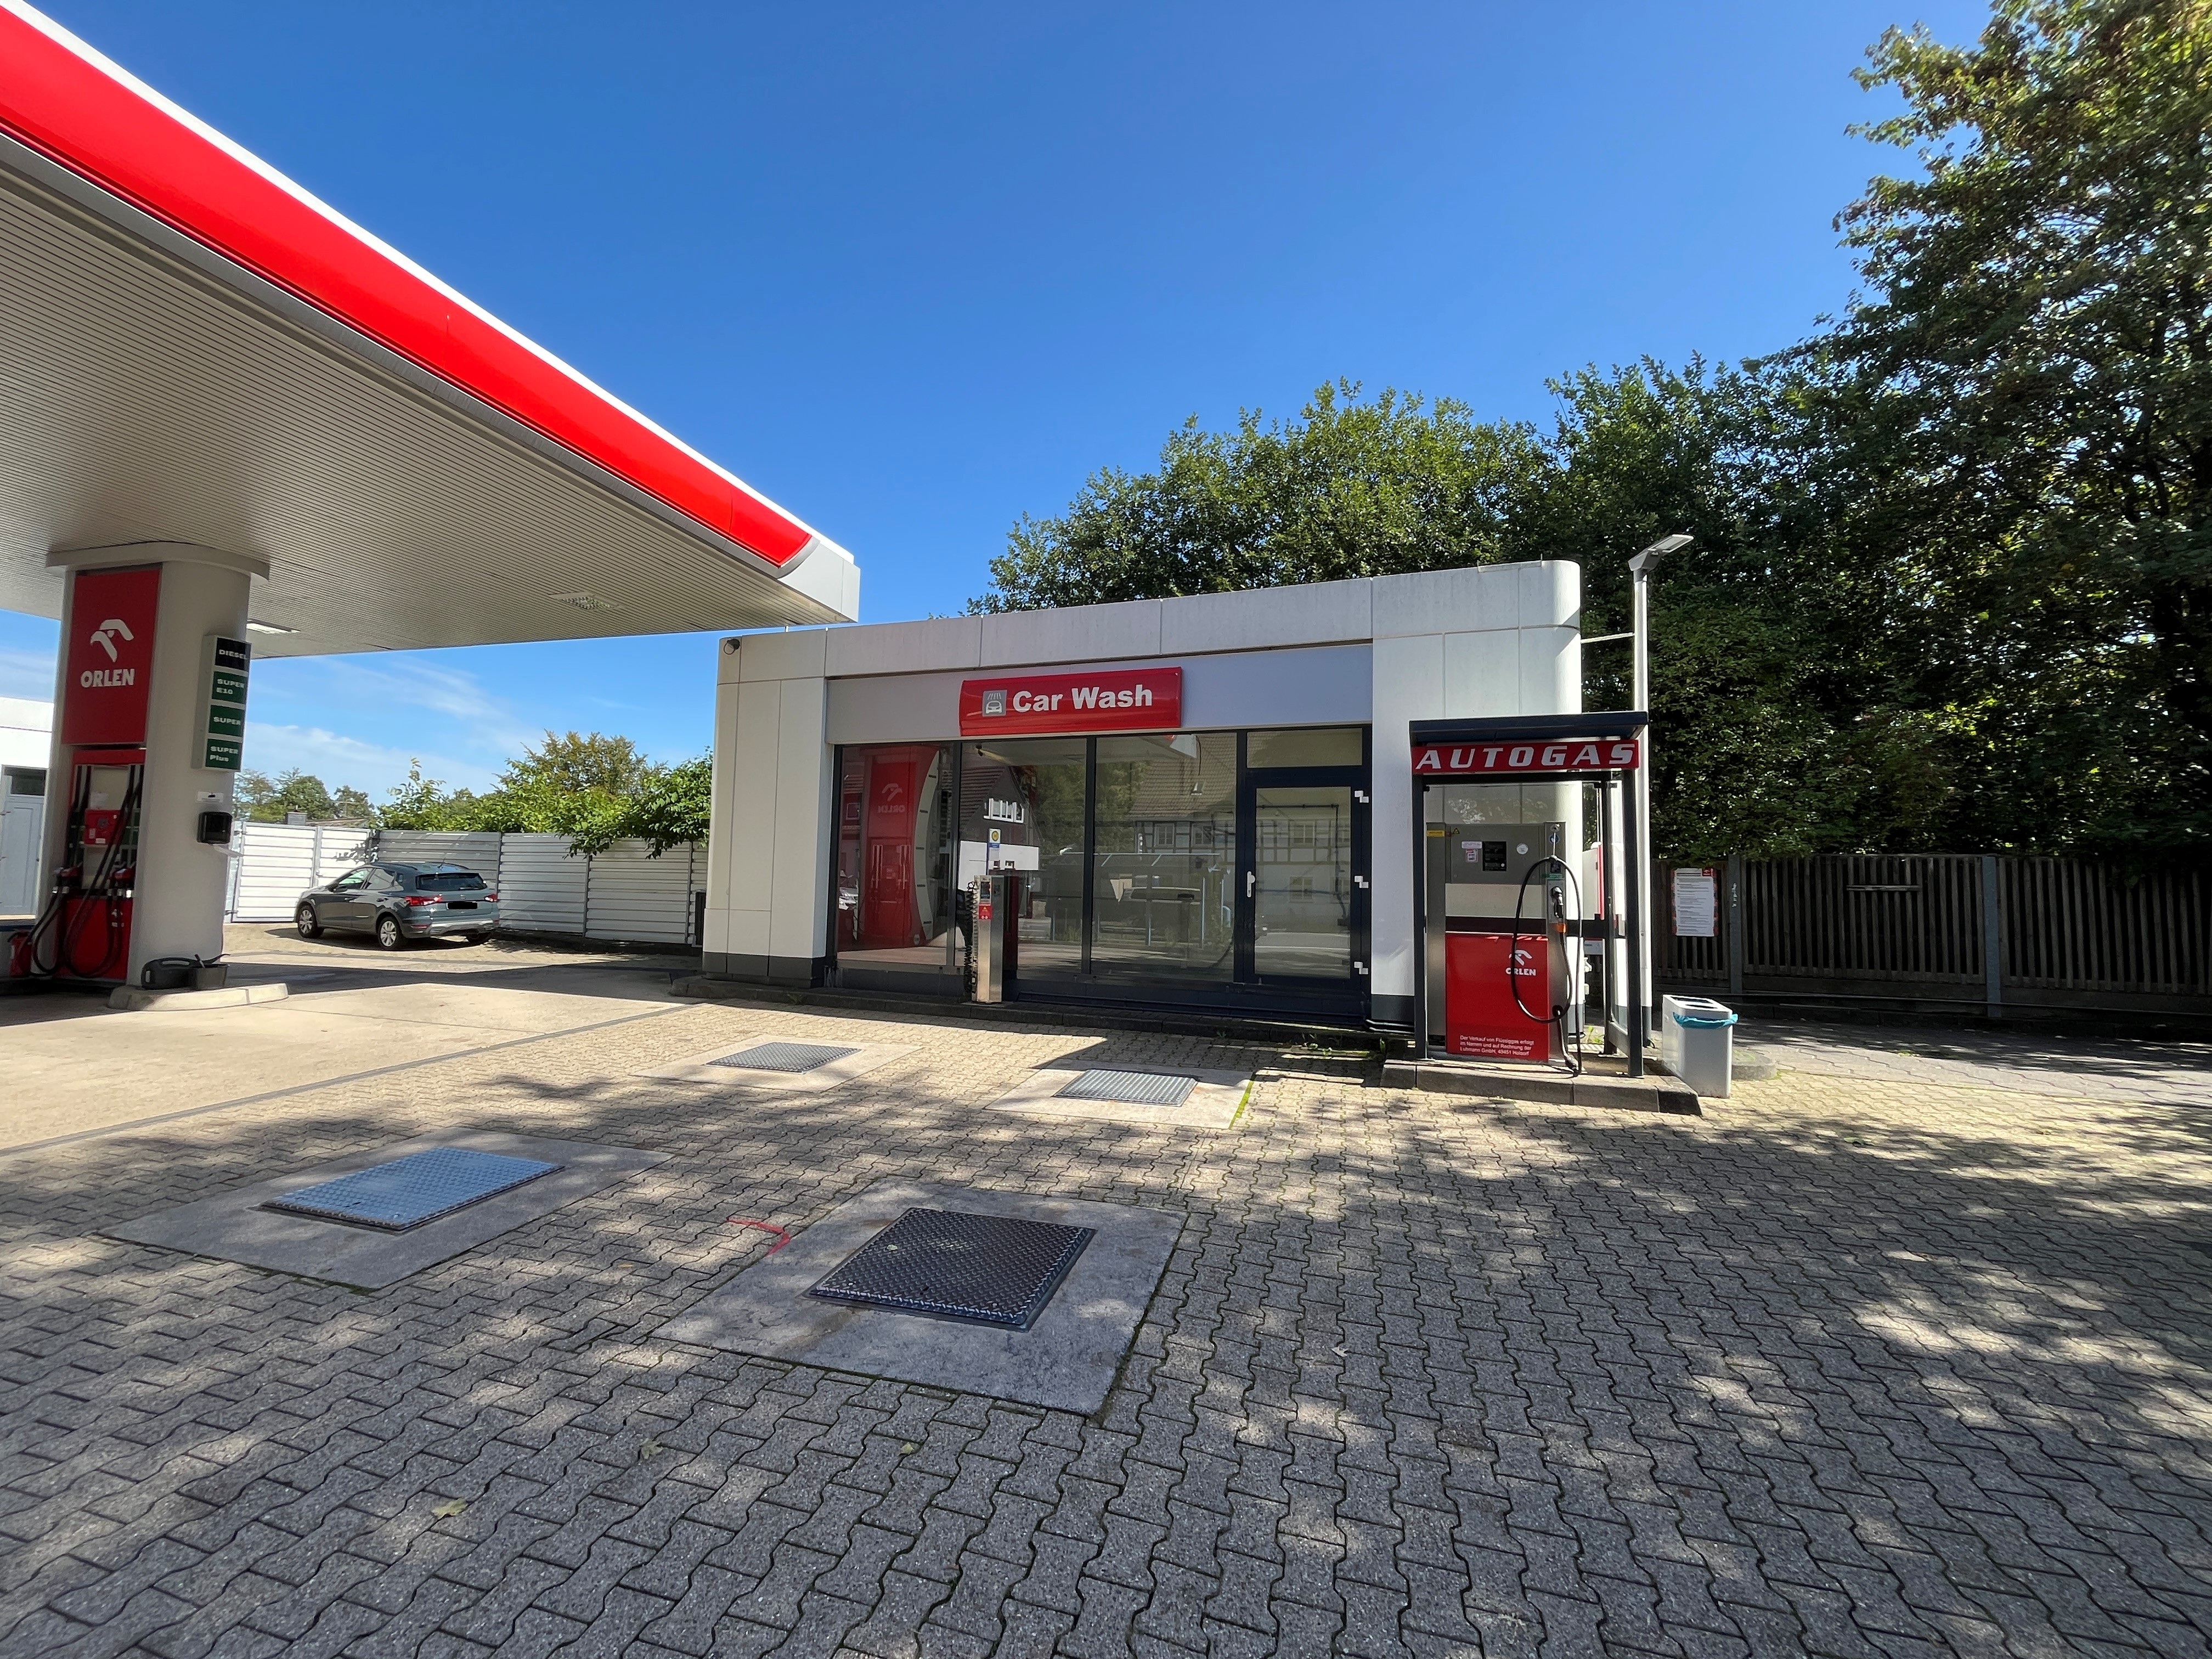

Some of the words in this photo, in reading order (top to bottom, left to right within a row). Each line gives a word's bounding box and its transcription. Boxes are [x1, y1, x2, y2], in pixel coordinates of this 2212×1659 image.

[218, 649, 247, 659] DIESEL
[80, 668, 135, 688] ORLEN
[217, 679, 244, 689] SUPER
[216, 687, 233, 695] E10
[1013, 691, 1063, 712] Car
[1071, 684, 1153, 709] Wash
[213, 716, 241, 725] SUPER
[211, 746, 238, 754] SUPER
[1415, 744, 1635, 770] AUTOGAS
[1505, 967, 1536, 976] ORLEN
